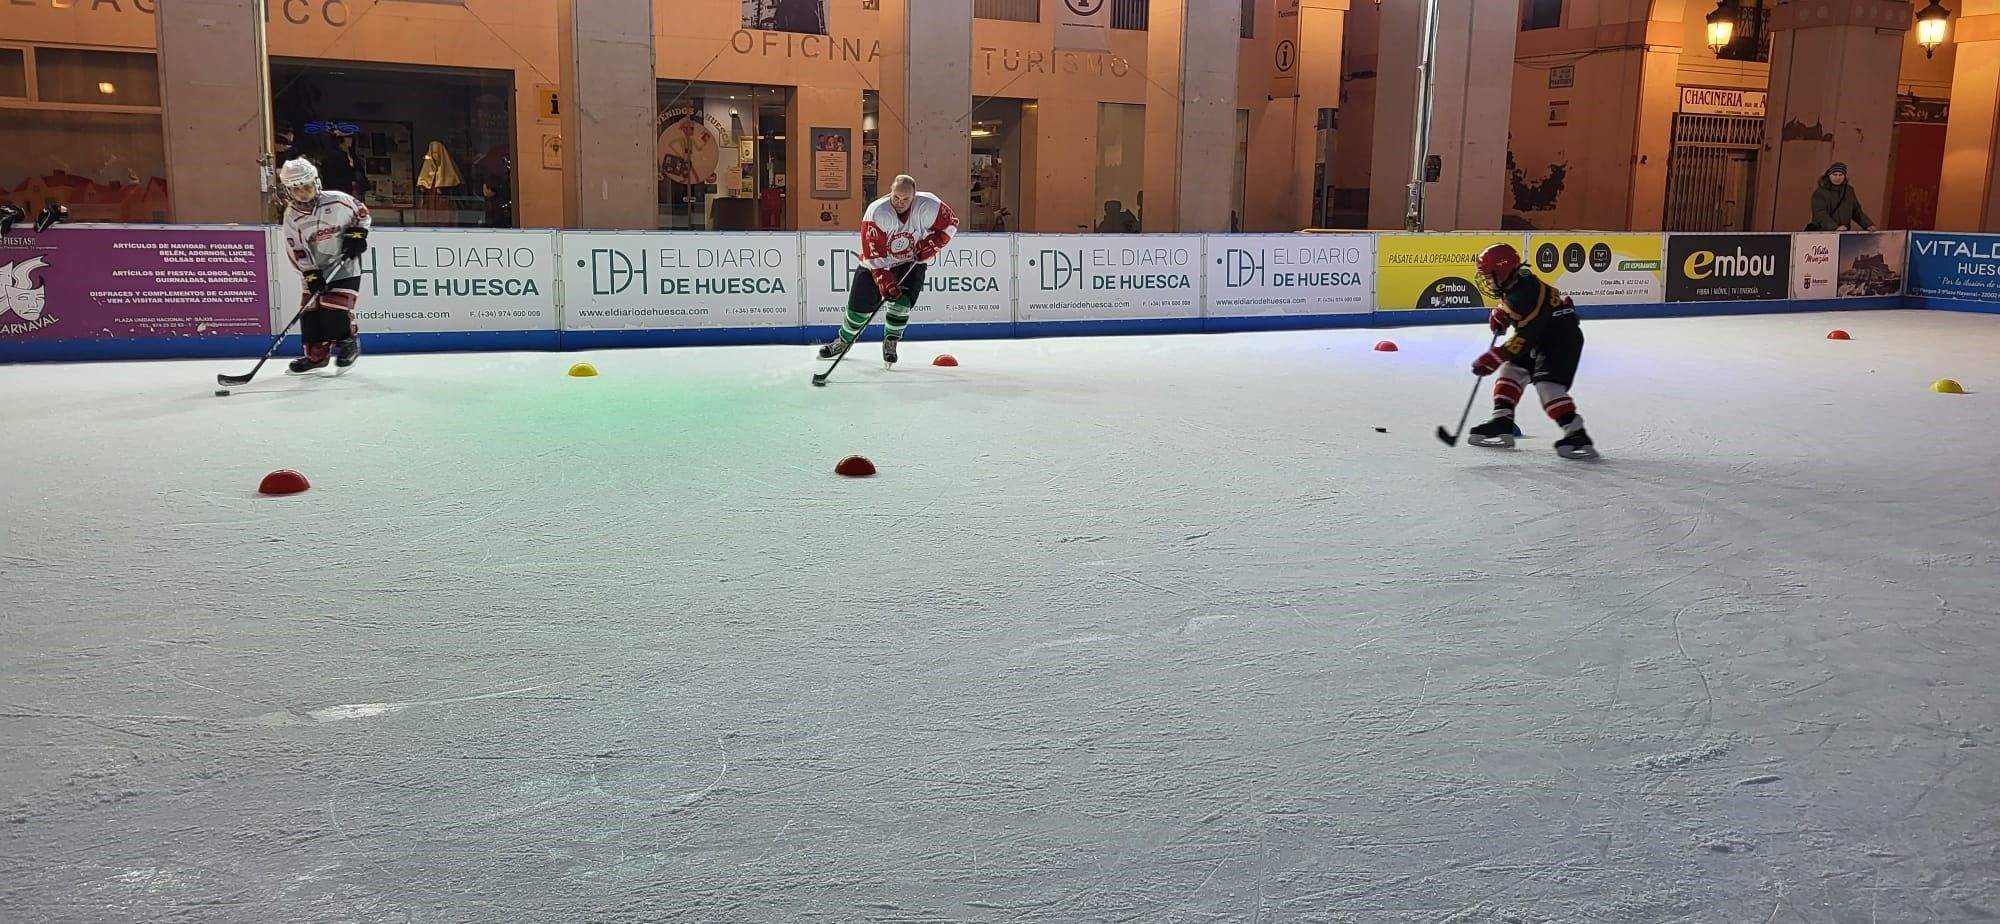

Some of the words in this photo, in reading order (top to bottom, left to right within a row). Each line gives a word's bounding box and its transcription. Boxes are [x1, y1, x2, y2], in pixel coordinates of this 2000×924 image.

[731, 29, 880, 63] OFICINA
[980, 47, 1129, 78] TURISMO
[1685, 89, 1742, 107] CHACINERIA
[392, 247, 427, 268] EL
[436, 247, 535, 268] DIARIO
[660, 248, 690, 268] EL
[697, 248, 782, 268] DIARIO
[1092, 249, 1117, 266] EL
[1122, 248, 1189, 266] DIARIO
[1273, 248, 1295, 265] EL
[1299, 247, 1360, 265] DIARIO
[1388, 252, 1413, 264] PÁSATE
[1414, 254, 1419, 264] A
[1420, 254, 1429, 264] LA
[1430, 253, 1471, 264] OPERADORA
[1683, 246, 1775, 280] embou
[393, 279, 429, 296] DE
[434, 278, 539, 296] HUESCA
[660, 278, 690, 295] DE
[695, 277, 786, 294] HUESCA
[1092, 275, 1116, 290] DE
[1120, 274, 1191, 290] HUESCA
[1273, 273, 1295, 287] DE
[1298, 272, 1362, 286] HUESCA
[1435, 282, 1466, 293] embou
[578, 307, 709, 317] www.eldiariodehuesca.com
[1029, 301, 1130, 310] www.eldiariodehuesca.com
